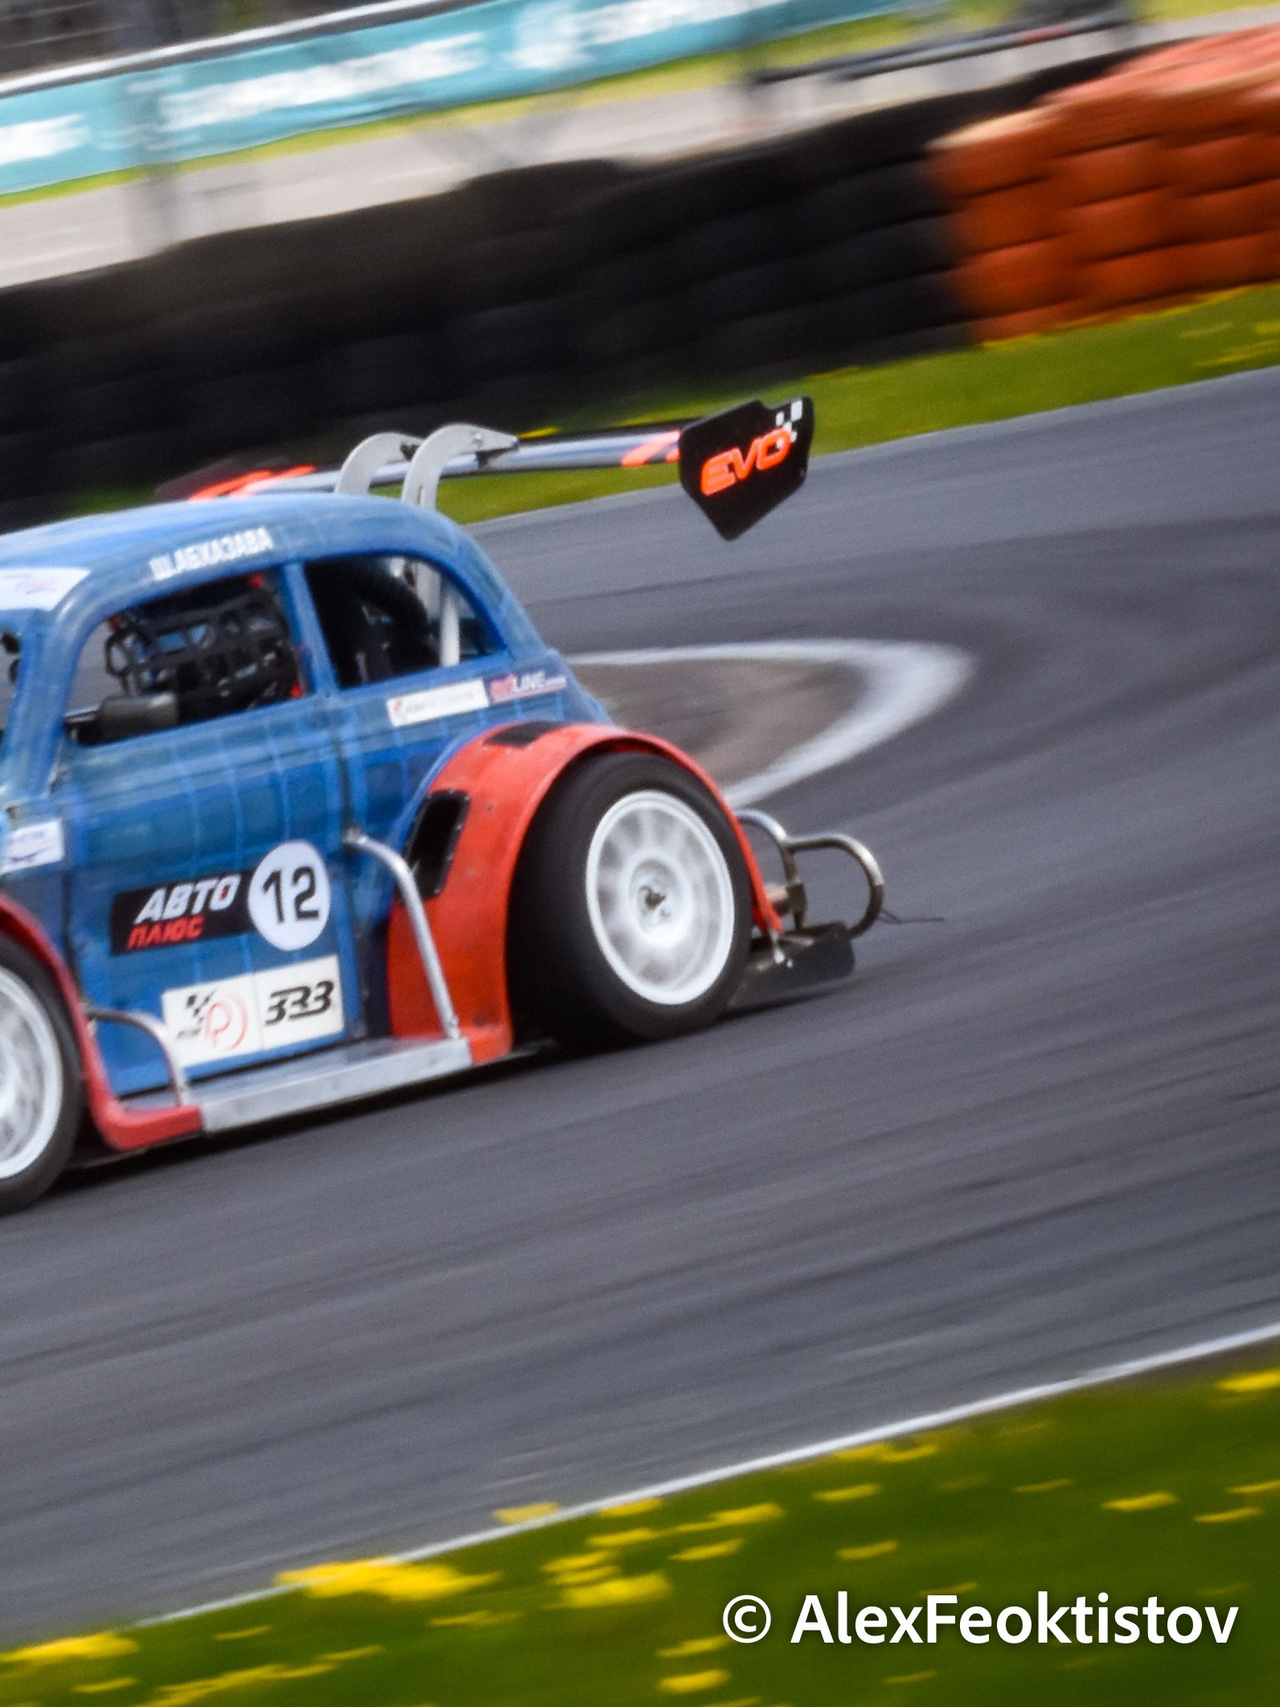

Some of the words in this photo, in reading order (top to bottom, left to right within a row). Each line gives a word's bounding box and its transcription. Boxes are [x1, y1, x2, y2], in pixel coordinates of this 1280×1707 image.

[700, 427, 791, 496] EVO
[133, 873, 242, 924] АВТО
[263, 865, 320, 923] 12
[126, 914, 205, 949] ПЛЮС
[265, 980, 335, 1027] 333
